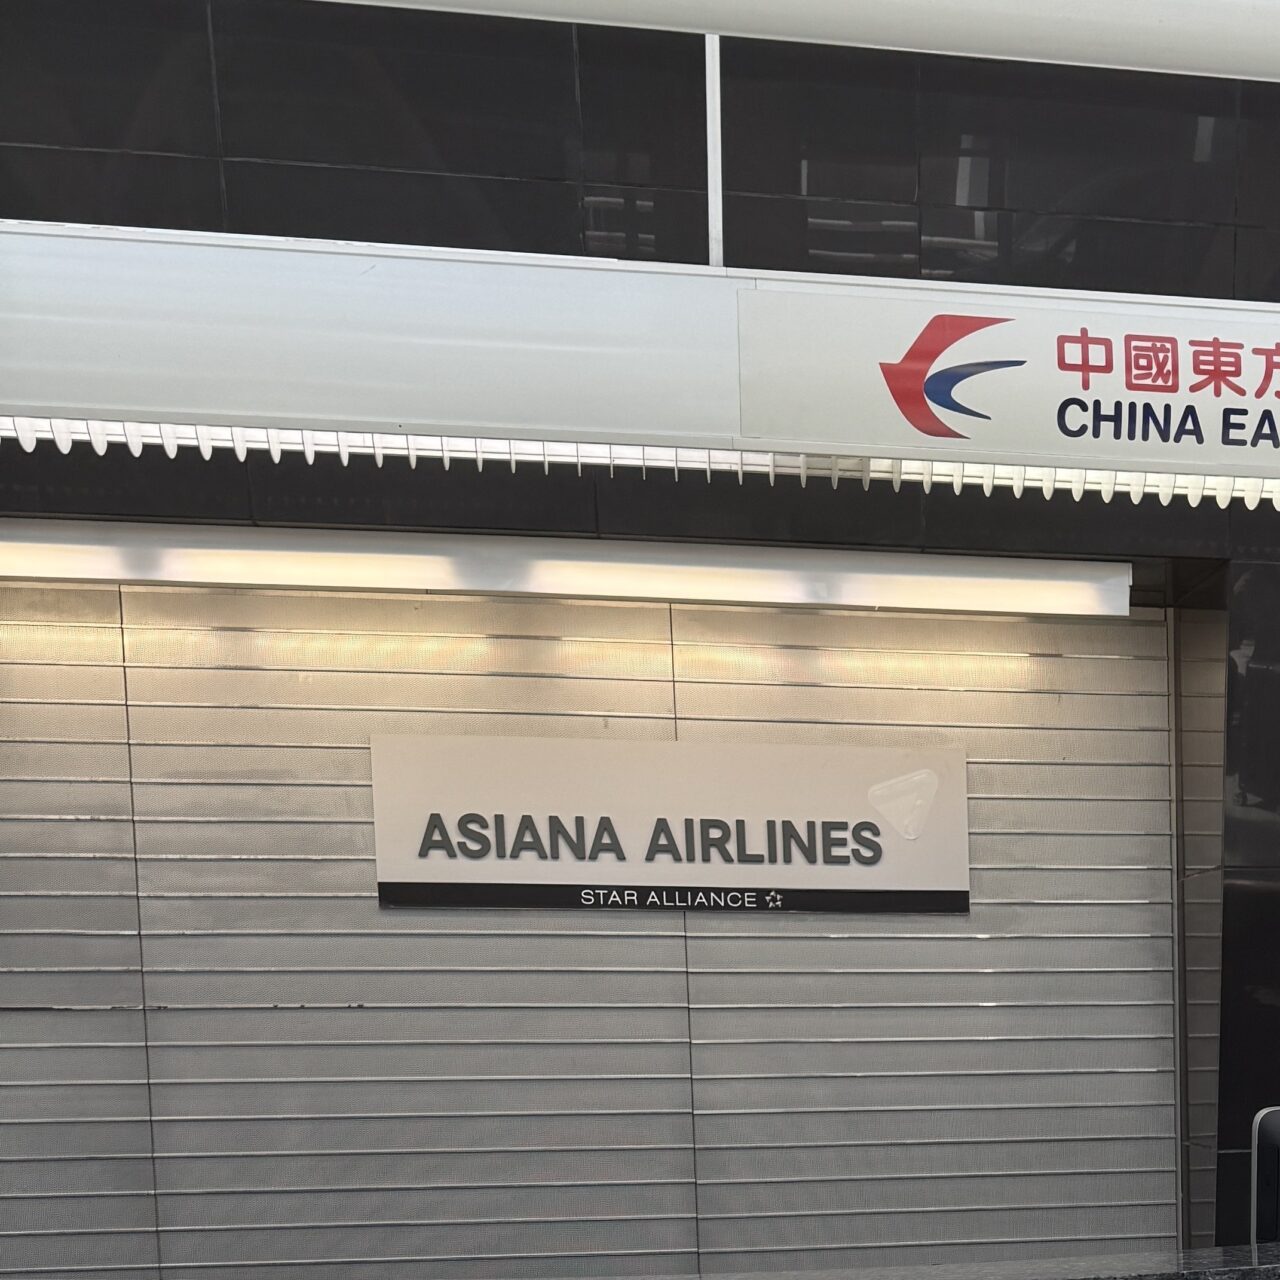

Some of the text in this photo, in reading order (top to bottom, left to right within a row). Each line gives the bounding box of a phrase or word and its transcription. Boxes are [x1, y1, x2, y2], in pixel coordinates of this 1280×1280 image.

[1056, 396, 1205, 445] CHINA
[417, 812, 884, 866] ASIANA AIRLINES
[580, 888, 758, 908] STAR ALLIANCE
